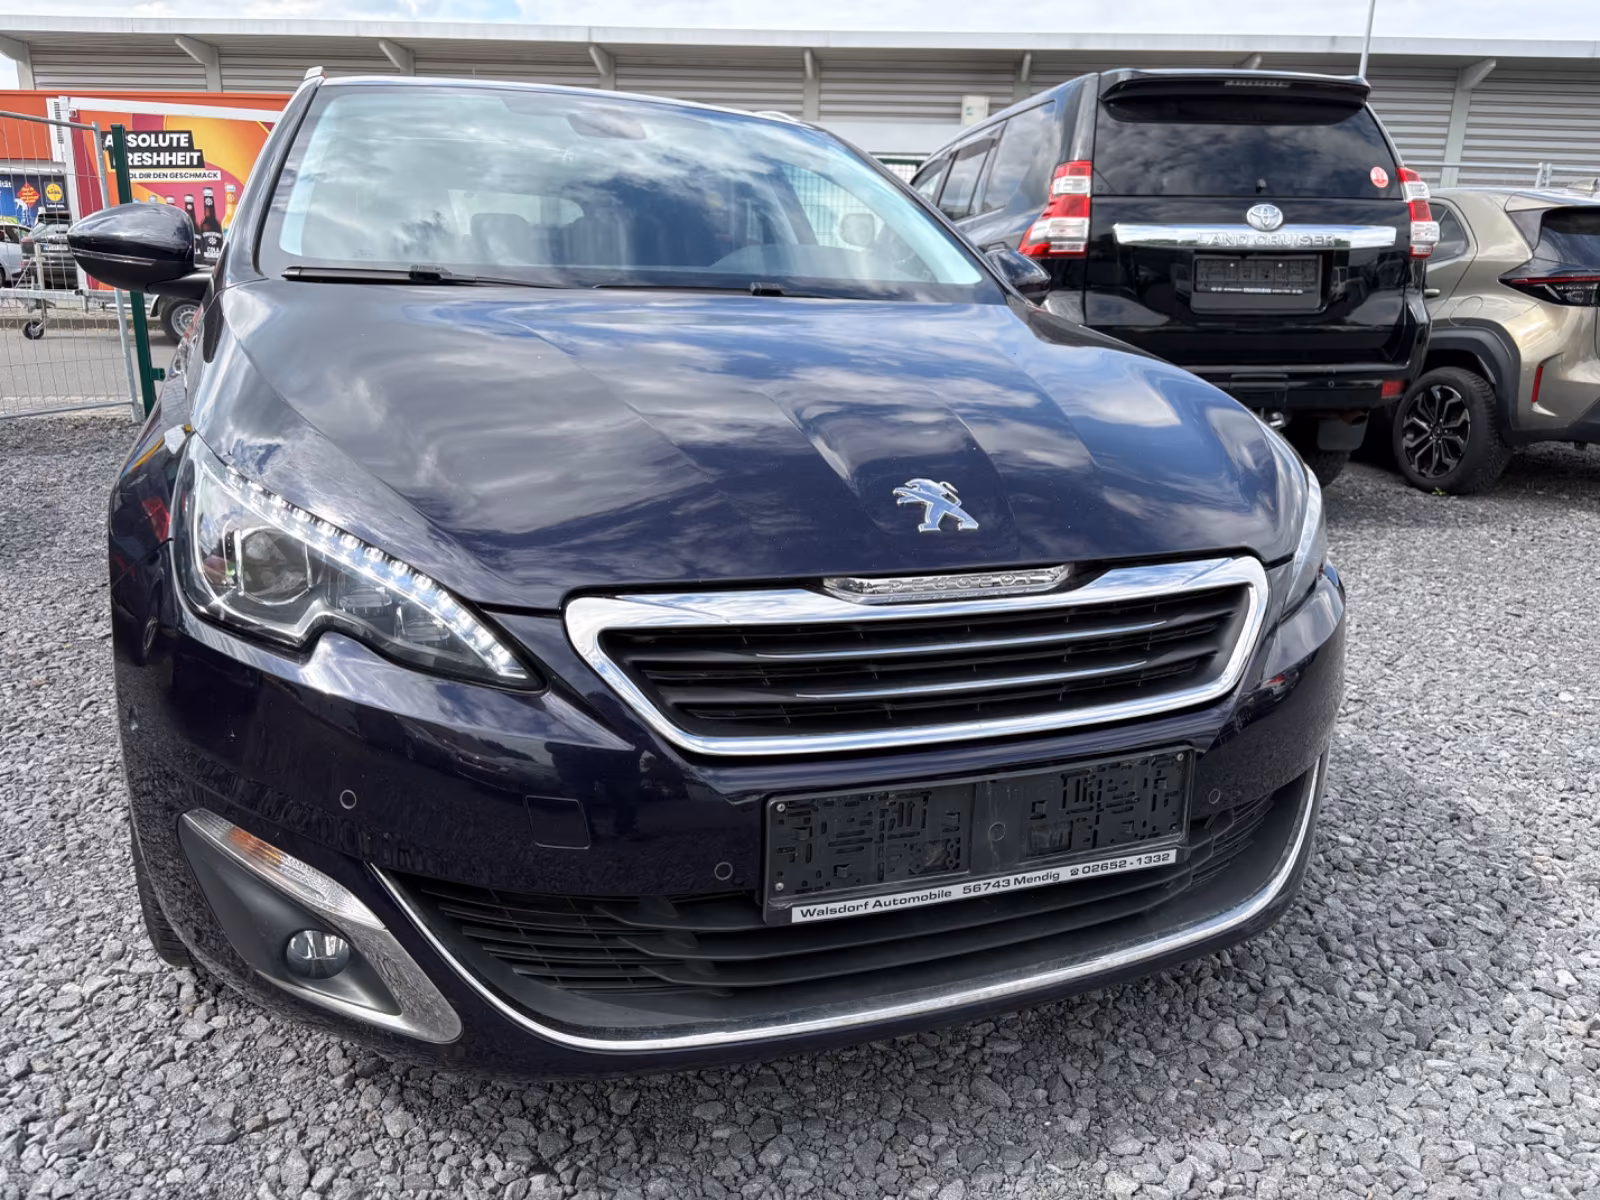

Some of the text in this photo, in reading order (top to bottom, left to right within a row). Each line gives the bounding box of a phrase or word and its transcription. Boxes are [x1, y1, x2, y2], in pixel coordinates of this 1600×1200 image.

[104, 133, 189, 148] ASOLUTE
[113, 152, 201, 166] RESHHEIT
[1197, 232, 1336, 247] LAND CRUISER
[889, 574, 1033, 593] PEUGEOT
[800, 901, 869, 918] Walsdorf
[872, 890, 952, 909] Automobile
[962, 878, 1011, 895] 56743
[1013, 870, 1060, 887] Mendig
